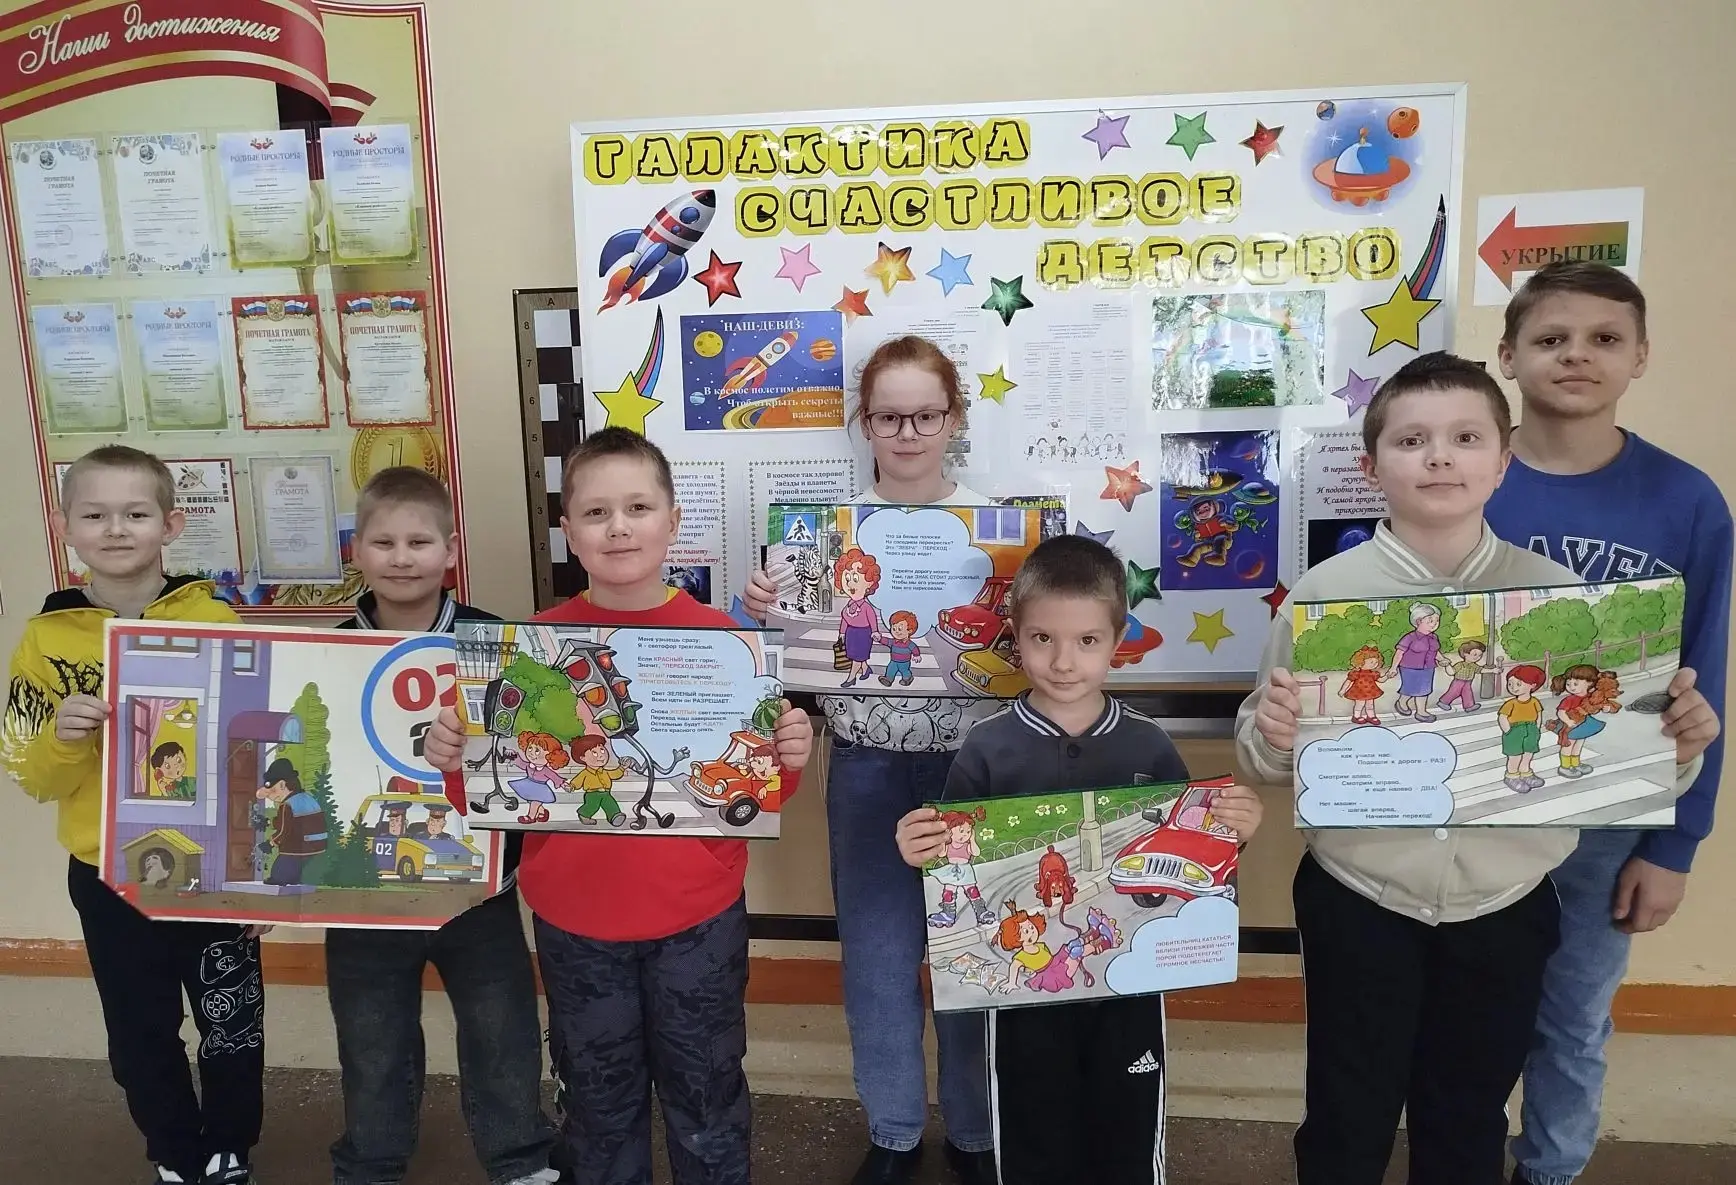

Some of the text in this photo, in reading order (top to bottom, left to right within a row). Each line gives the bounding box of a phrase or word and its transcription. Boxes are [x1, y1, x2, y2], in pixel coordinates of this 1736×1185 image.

[18, 4, 281, 74] Наши достижения
[592, 119, 1030, 180] ГАЛАКТИКА
[740, 175, 1237, 234] СЧАСТЛИВОЕ
[1039, 227, 1396, 286] ДЕТСТВО
[1500, 243, 1620, 265] УКРЫТИЕ
[547, 297, 556, 306] A
[724, 321, 756, 332] НАШ
[704, 387, 711, 395] В
[1355, 496, 1376, 504] яркой
[375, 842, 393, 856] 02
[1128, 1061, 1159, 1074] adidas
